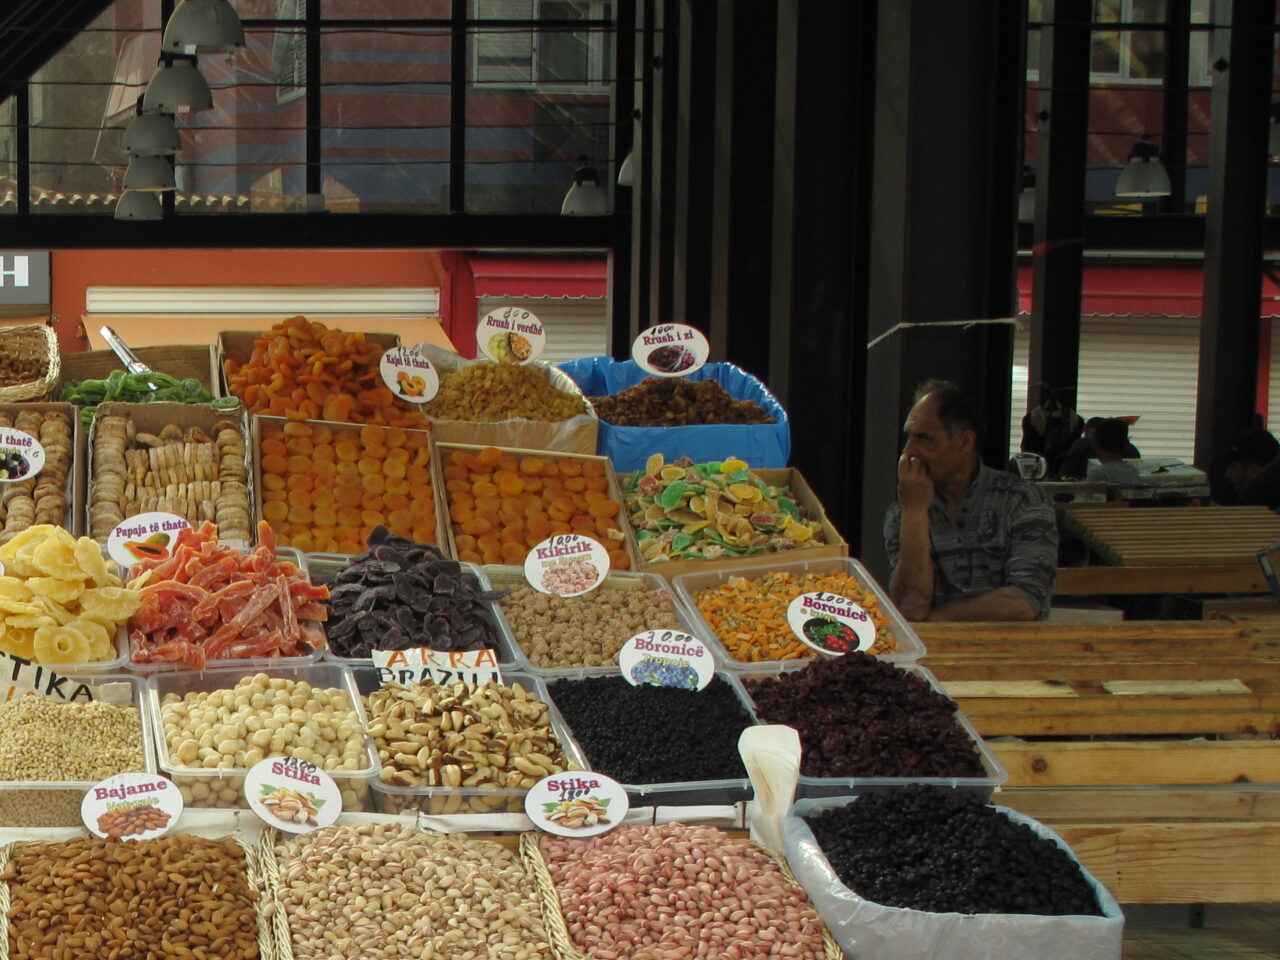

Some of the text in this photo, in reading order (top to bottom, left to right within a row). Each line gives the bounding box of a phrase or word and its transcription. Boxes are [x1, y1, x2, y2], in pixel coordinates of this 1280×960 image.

[487, 315, 543, 335] Rrush i verdhë
[643, 333, 674, 345] Rrush
[684, 329, 693, 340] zi
[0, 433, 3, 444] i
[5, 435, 32, 447] thatë
[116, 520, 187, 538] Papaja të thata
[536, 541, 592, 559] Kikirik
[802, 596, 867, 622] Boronicë
[387, 646, 496, 668] ARRA
[634, 638, 704, 657] Boronicë
[272, 762, 321, 785] Stika
[94, 781, 167, 800] Bajame
[547, 778, 601, 791] Stika
